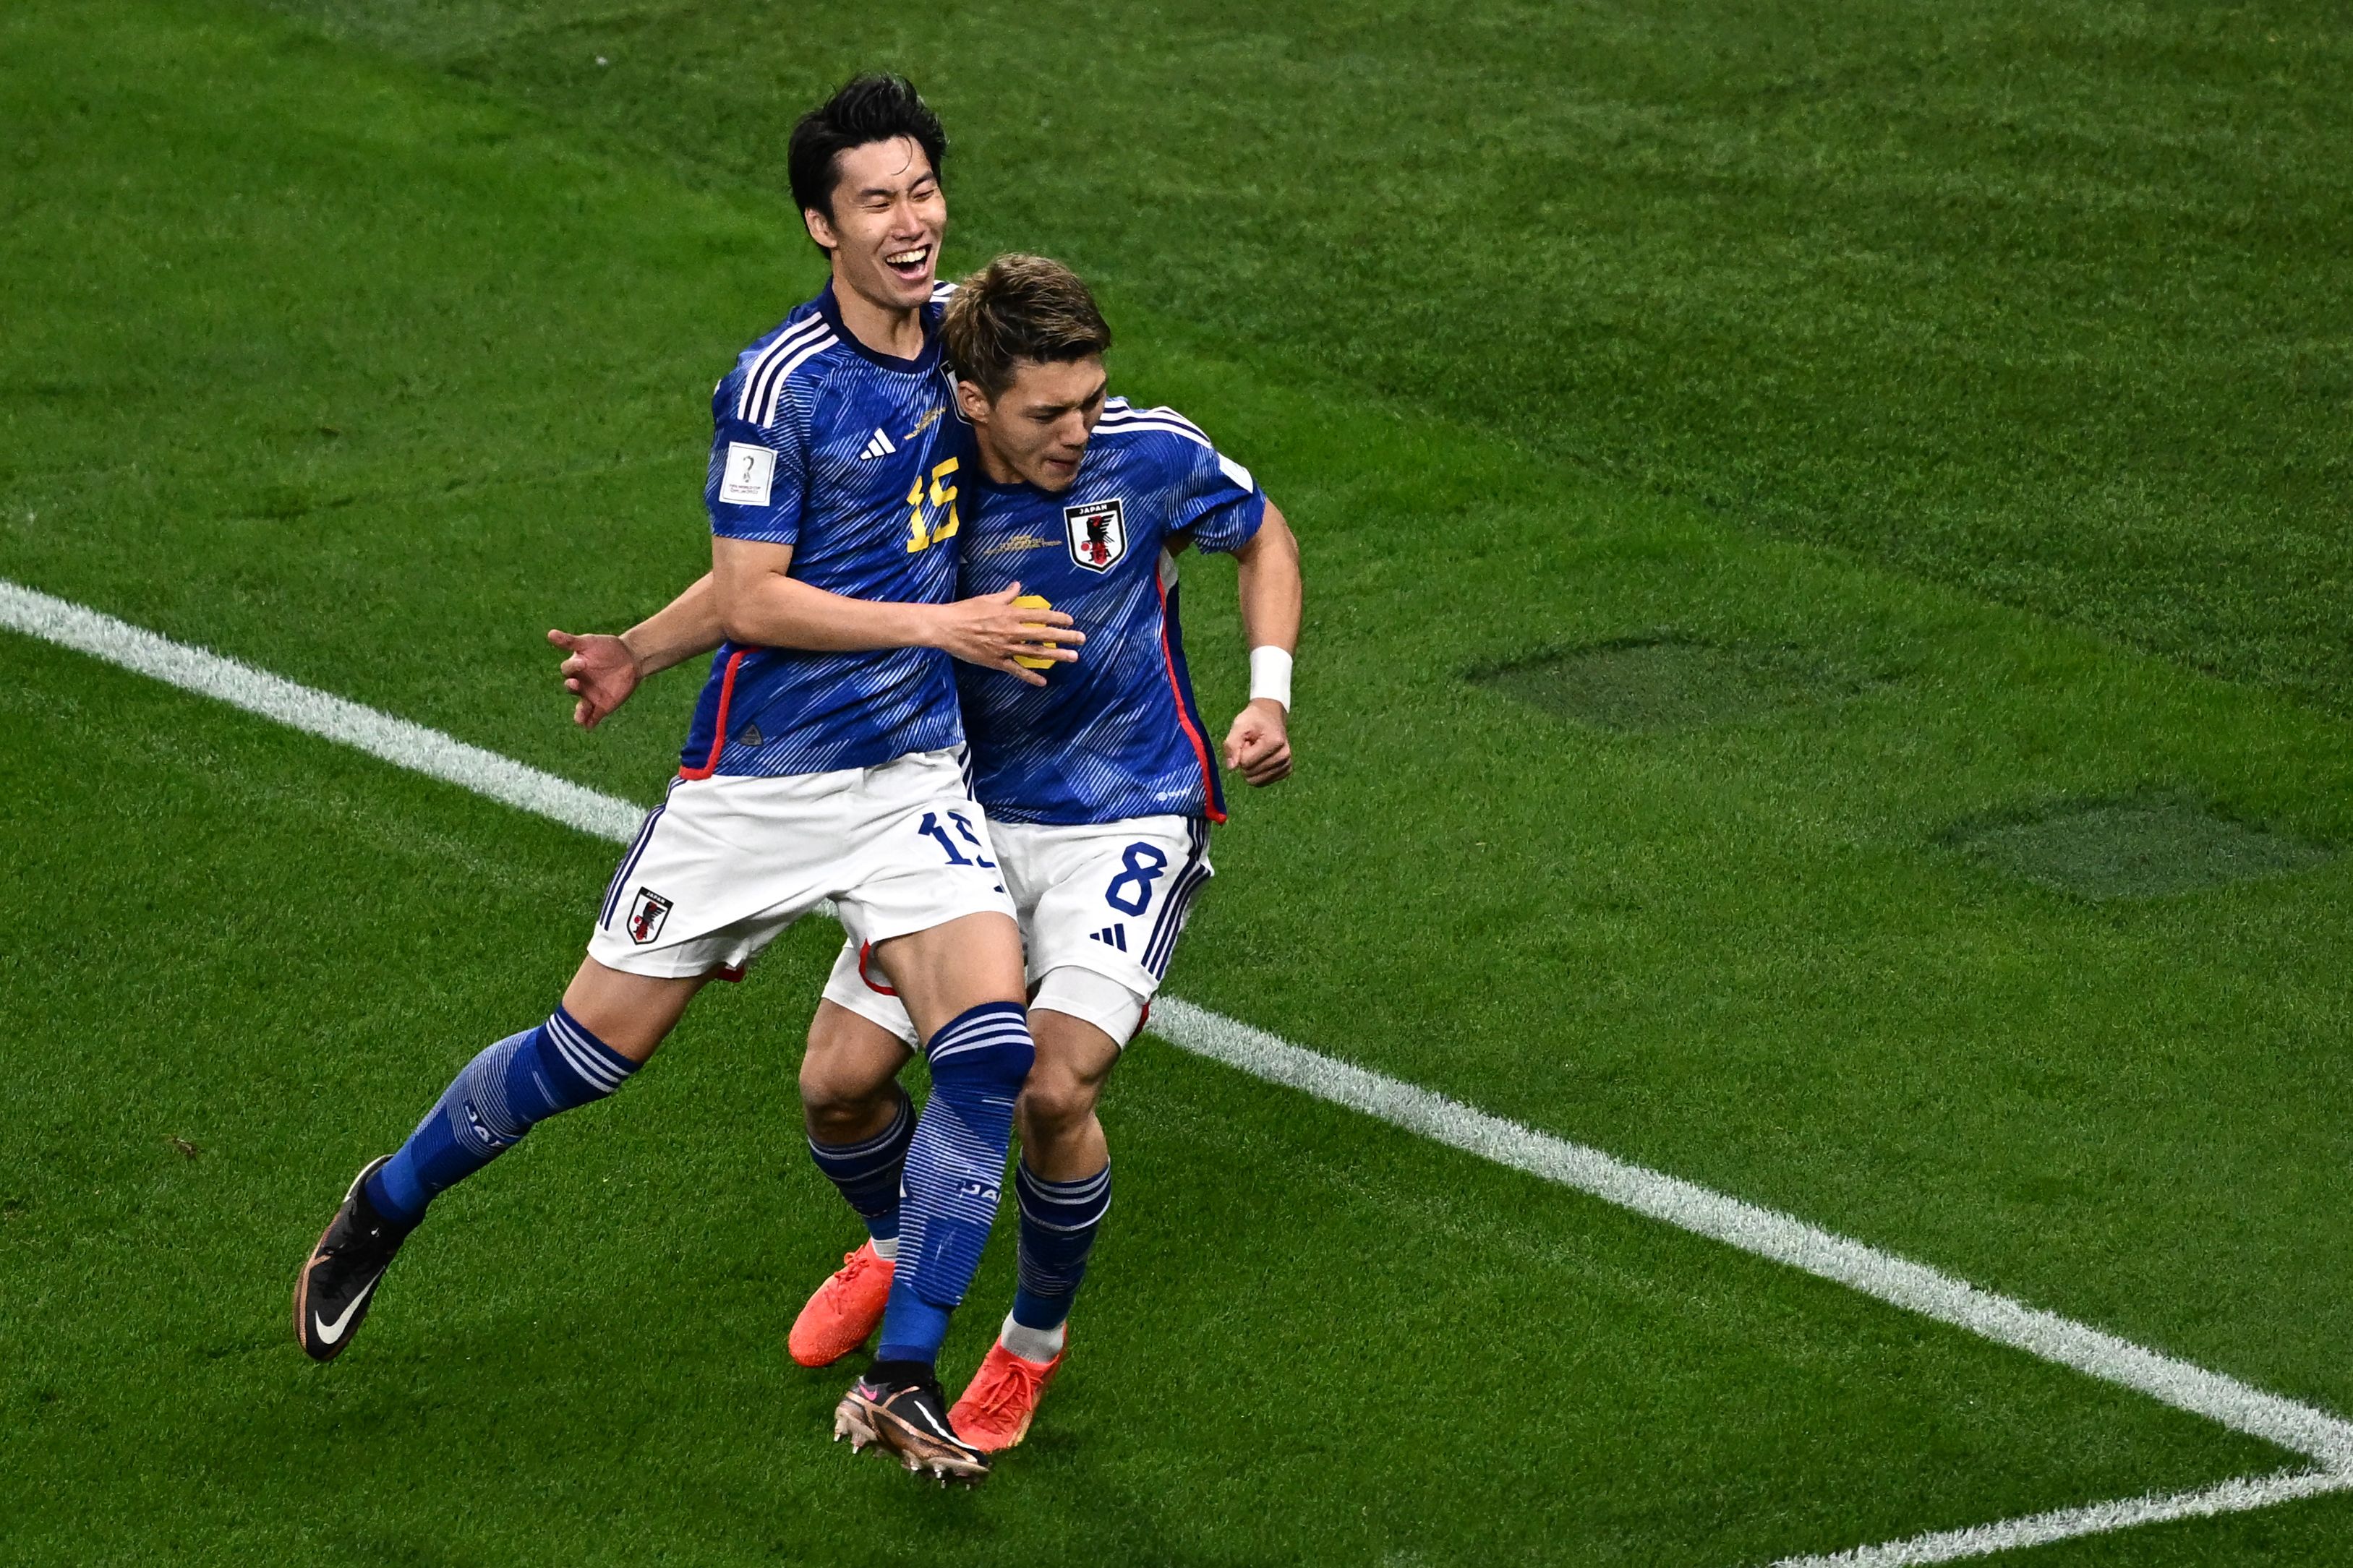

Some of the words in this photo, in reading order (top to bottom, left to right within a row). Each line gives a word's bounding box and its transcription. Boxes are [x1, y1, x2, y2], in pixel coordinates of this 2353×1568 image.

[907, 456, 960, 553] 15
[1079, 504, 1107, 515] JAPAN
[1105, 841, 1168, 917] 8
[646, 891, 665, 904] JAPAN
[962, 1184, 1002, 1204] JA
